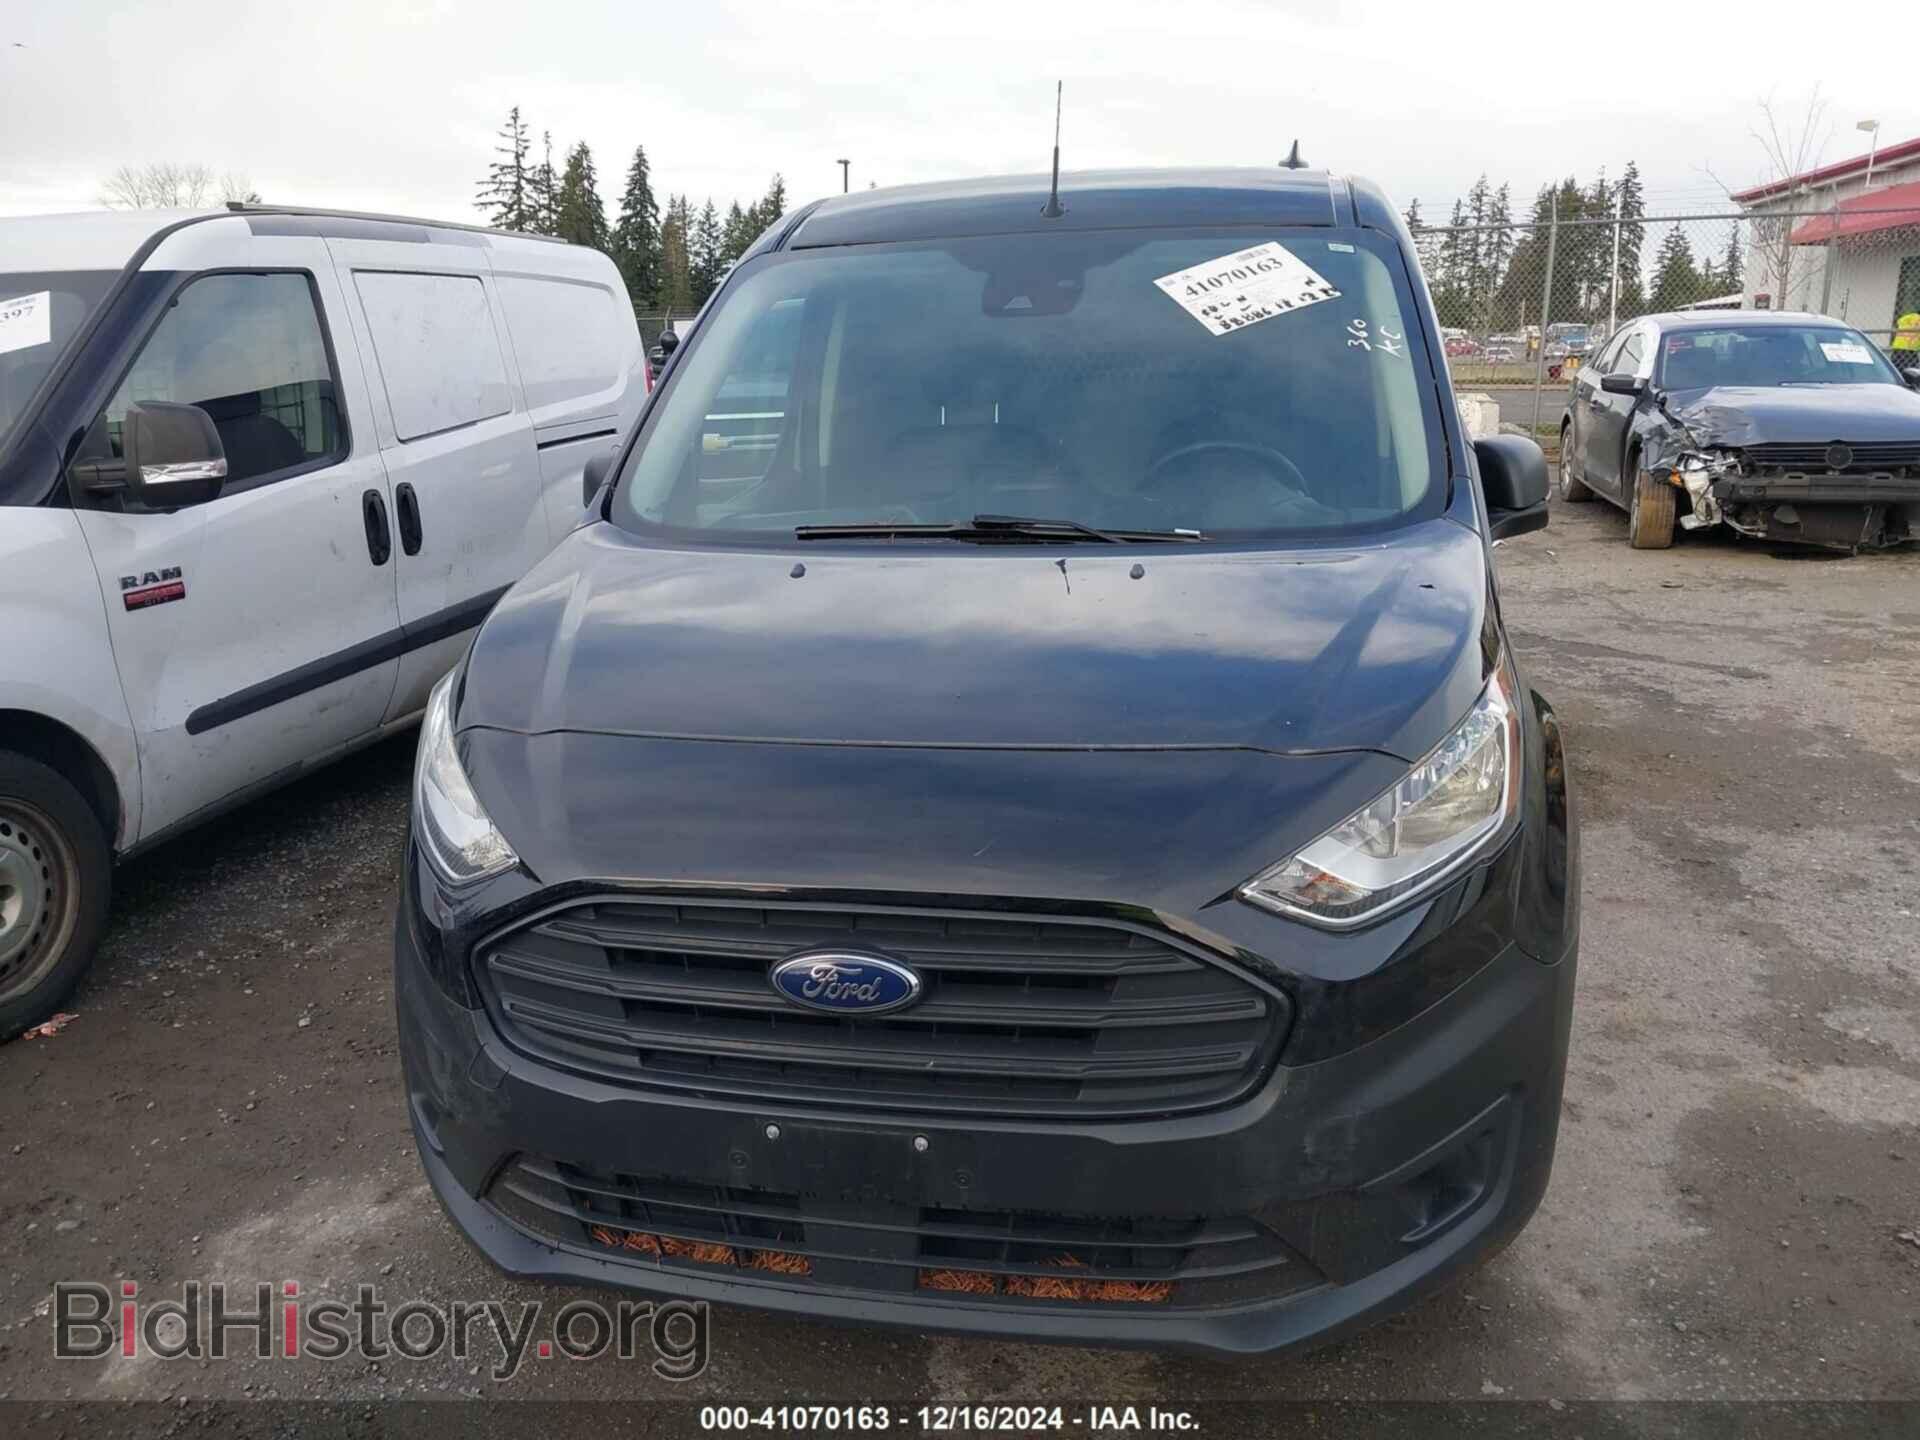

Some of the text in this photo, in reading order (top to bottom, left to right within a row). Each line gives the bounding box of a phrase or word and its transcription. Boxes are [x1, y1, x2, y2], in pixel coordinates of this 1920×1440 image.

[1185, 257, 1284, 297] 41070163
[1346, 319, 1372, 351] 360
[119, 566, 183, 590] RAM
[802, 963, 883, 1001] Ford
